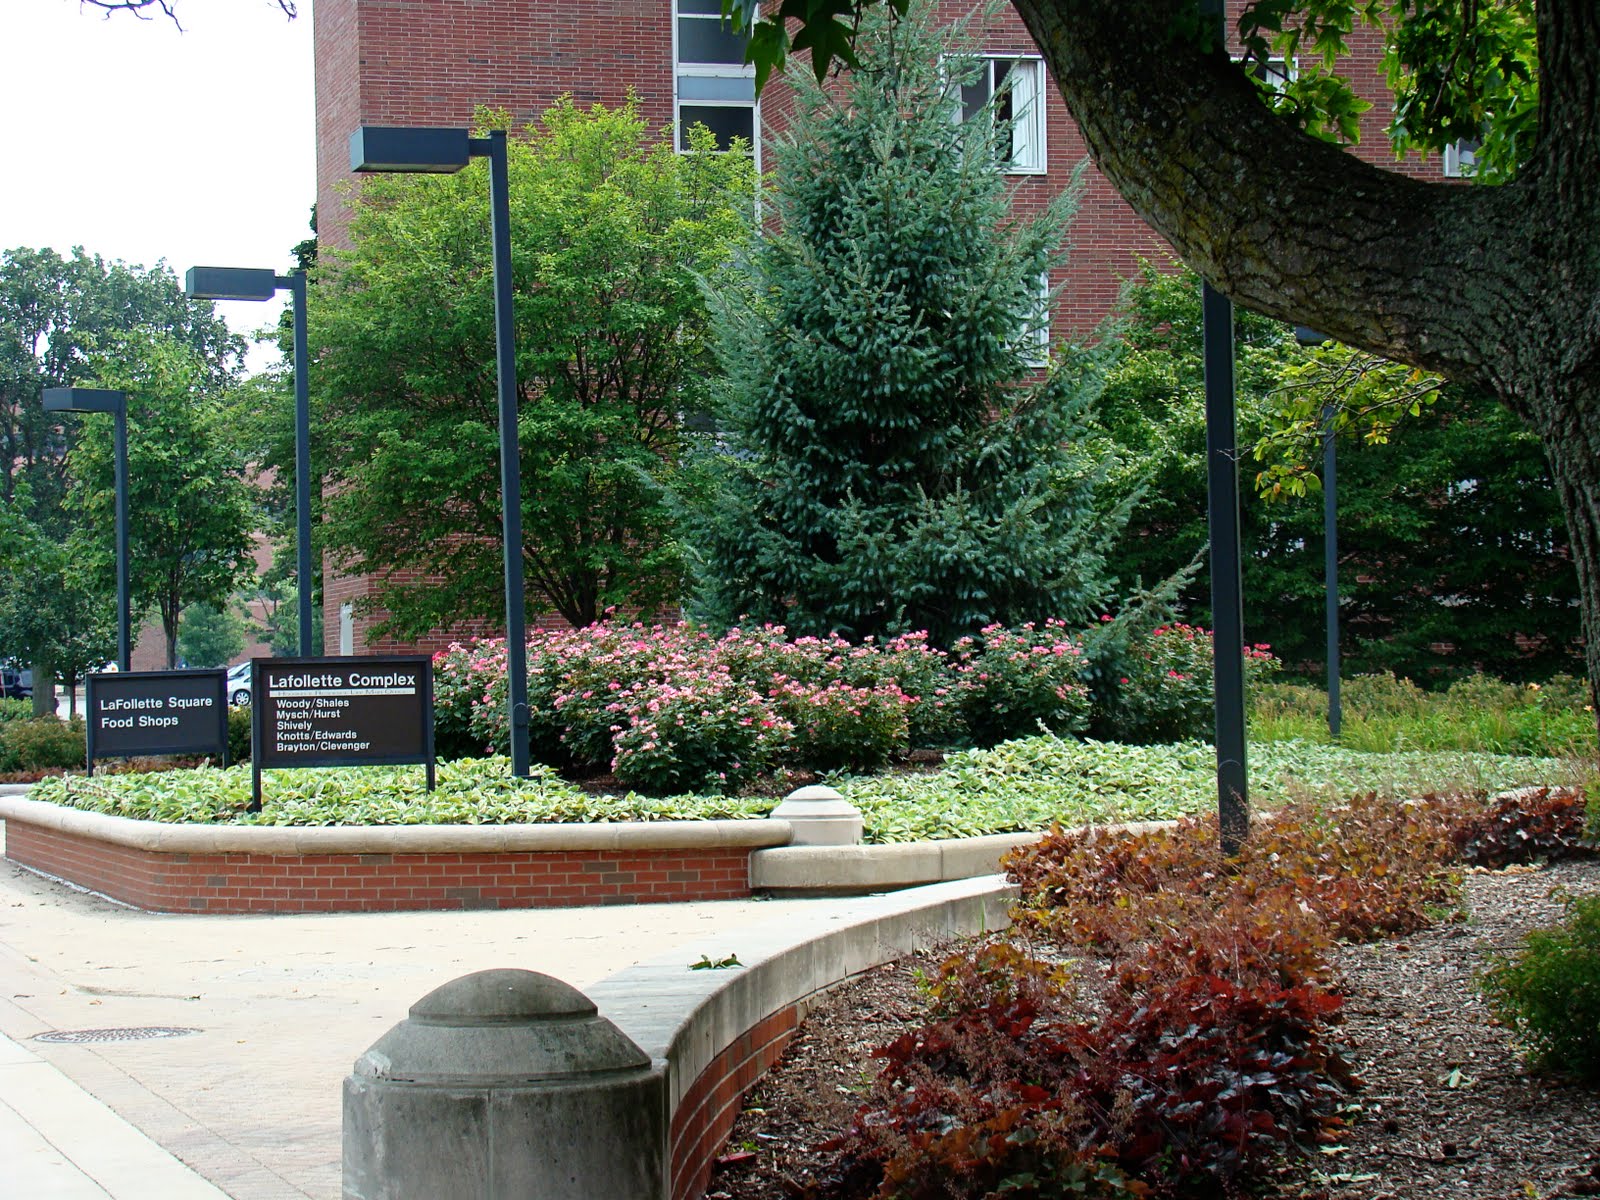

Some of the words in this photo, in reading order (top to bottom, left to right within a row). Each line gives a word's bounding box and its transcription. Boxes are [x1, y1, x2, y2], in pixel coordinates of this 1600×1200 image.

[269, 674, 343, 688] Lafollette
[349, 673, 416, 688] Complex
[100, 698, 163, 711] LaFollette
[168, 697, 213, 709] Square
[276, 698, 350, 709] Woody/Shales
[276, 709, 341, 720] Mysch/Hurst
[101, 716, 134, 729] Food
[138, 715, 179, 728] Shops
[276, 720, 313, 731] Shively
[276, 730, 358, 741] Knotts/Edwards
[276, 741, 371, 752] Brayton/Clevenger
